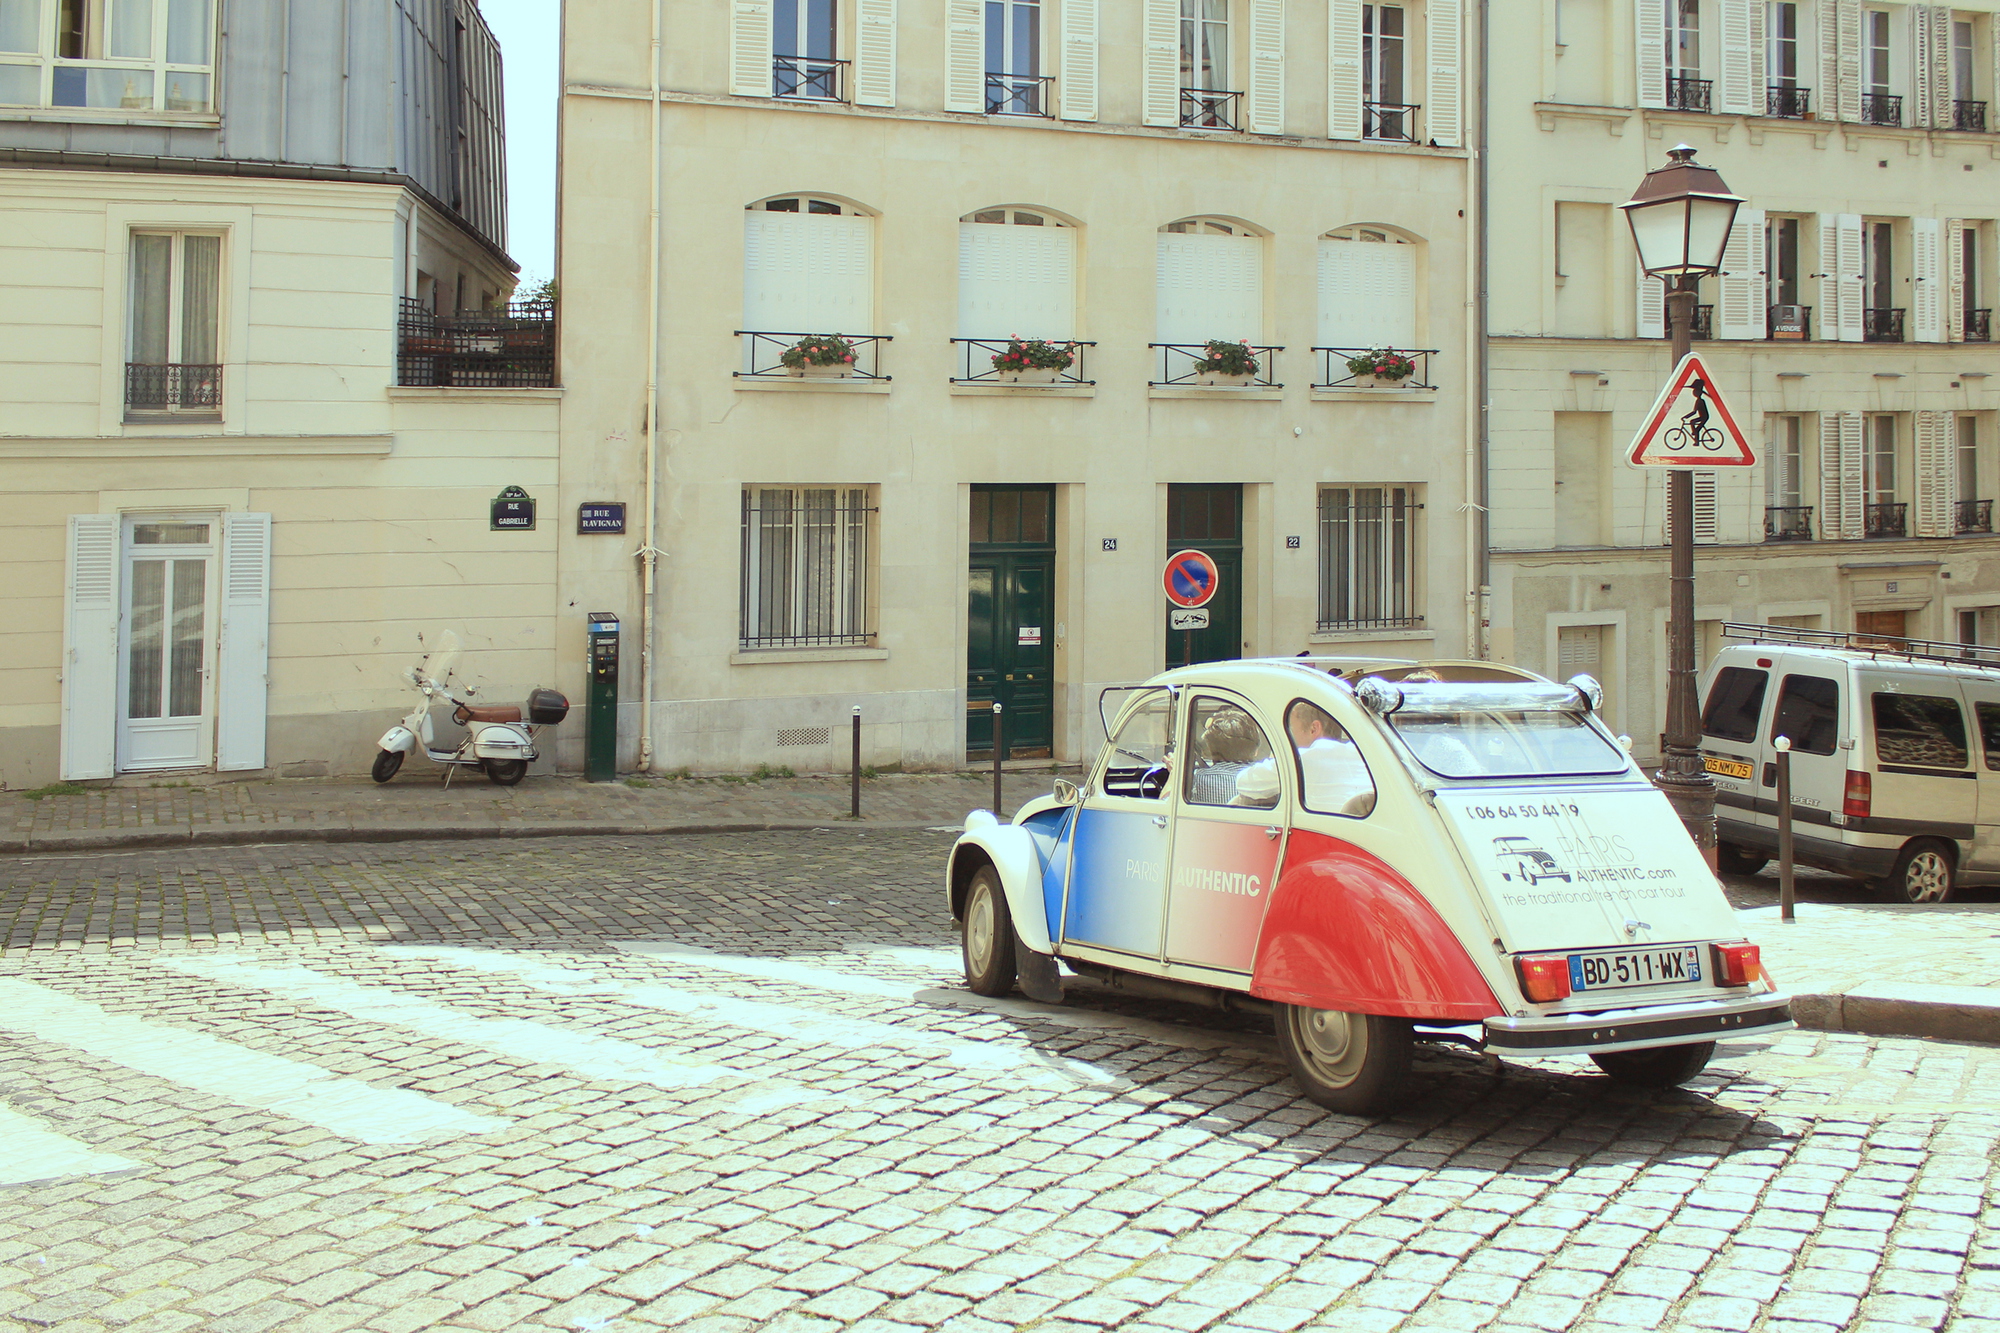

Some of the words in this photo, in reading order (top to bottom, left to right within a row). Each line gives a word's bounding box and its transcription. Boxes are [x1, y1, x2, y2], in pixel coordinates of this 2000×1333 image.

[507, 502, 520, 510] RUE
[593, 509, 610, 517] RUE
[498, 517, 528, 525] GABRIELLE
[582, 519, 622, 527] RAVIGNAN
[1104, 539, 1116, 550] 24
[1288, 537, 1299, 547] 22
[1719, 761, 1736, 774] NMV
[1736, 764, 1749, 777] 75
[1475, 806, 1496, 819] 06
[1498, 805, 1518, 819] 64
[1519, 804, 1539, 818] 50
[1542, 804, 1560, 817] 44
[1556, 834, 1635, 864] PARIS
[1125, 858, 1160, 883] PARIS
[1175, 865, 1261, 897] AUTHENTIC
[1576, 867, 1677, 883] AUTHENTIC.com
[1502, 893, 1527, 906] the
[1528, 889, 1595, 905] traditional
[1638, 888, 1659, 900] car
[1659, 885, 1687, 898] tour
[1687, 965, 1700, 978] 75
[1574, 976, 1581, 985] F
